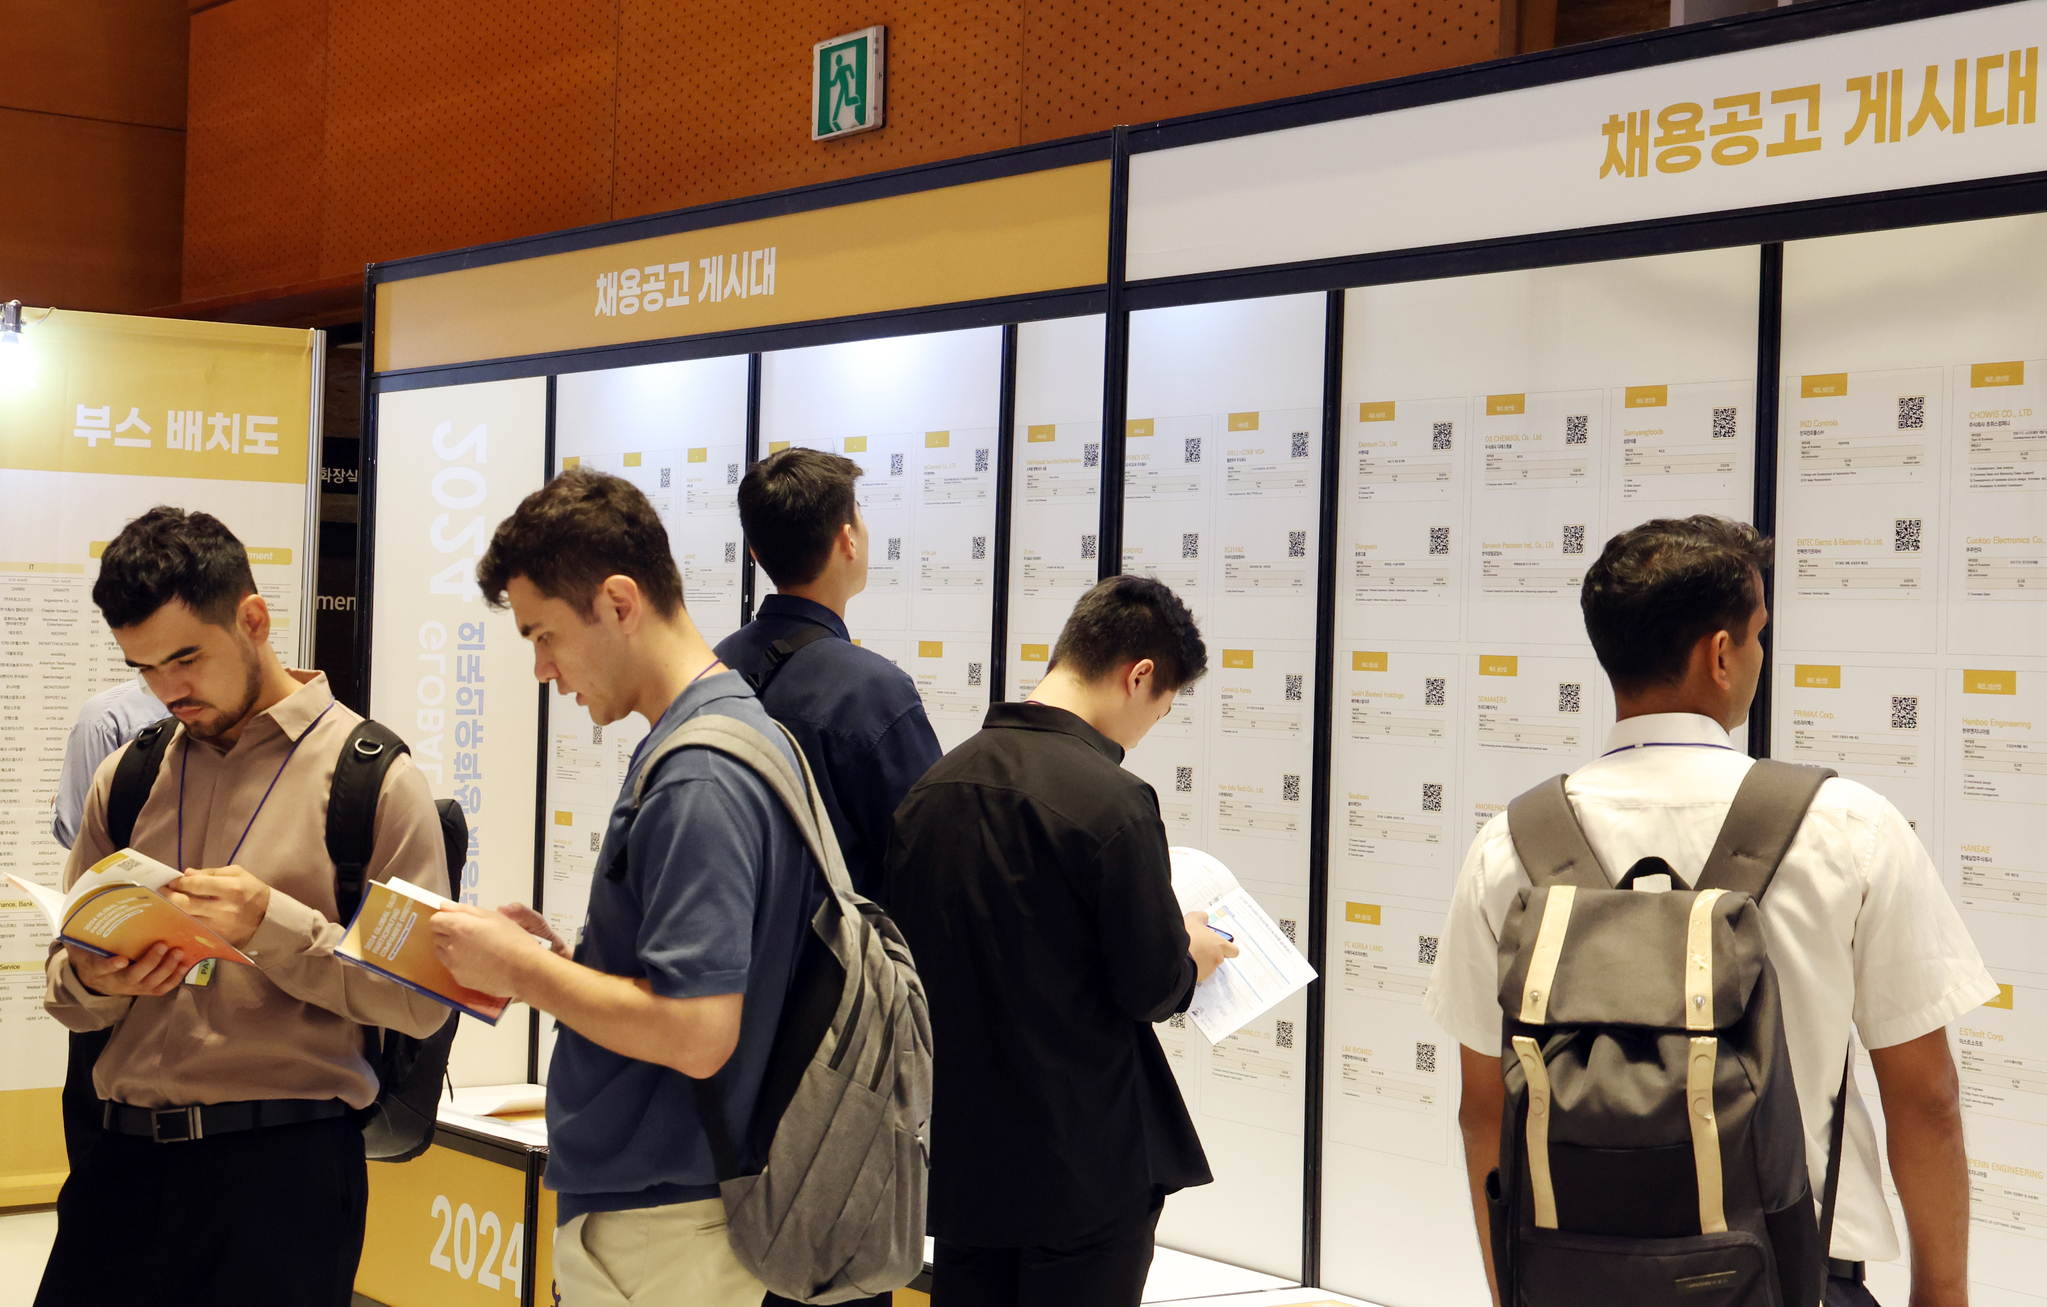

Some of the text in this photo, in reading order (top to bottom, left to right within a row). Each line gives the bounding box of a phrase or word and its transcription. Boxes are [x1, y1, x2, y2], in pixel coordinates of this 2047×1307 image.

[1599, 45, 2039, 180] 채용공고 게시대
[594, 246, 777, 317] 채용공고 게시대
[1969, 410, 2000, 420] CHOWIS
[2018, 408, 2033, 417] LTD
[73, 403, 279, 455] 부스 배치도
[320, 466, 359, 484] 화장실
[1796, 538, 1815, 546] ENTEC
[1993, 536, 2031, 545] Electronics
[1477, 695, 1508, 704] 3DMAKERS
[1793, 709, 1836, 720] PRIMAX Corp.
[1990, 718, 2032, 730] Engineering
[1960, 844, 1991, 854] HANSAE
[1351, 942, 1369, 951] KOREA
[1369, 944, 1384, 953] LAND
[1959, 1027, 2006, 1043] ESTsoft Corp.
[1352, 1046, 1373, 1057] BIOMED
[1991, 1162, 2044, 1180] ENGINEERING
[429, 1194, 524, 1300] 2024
